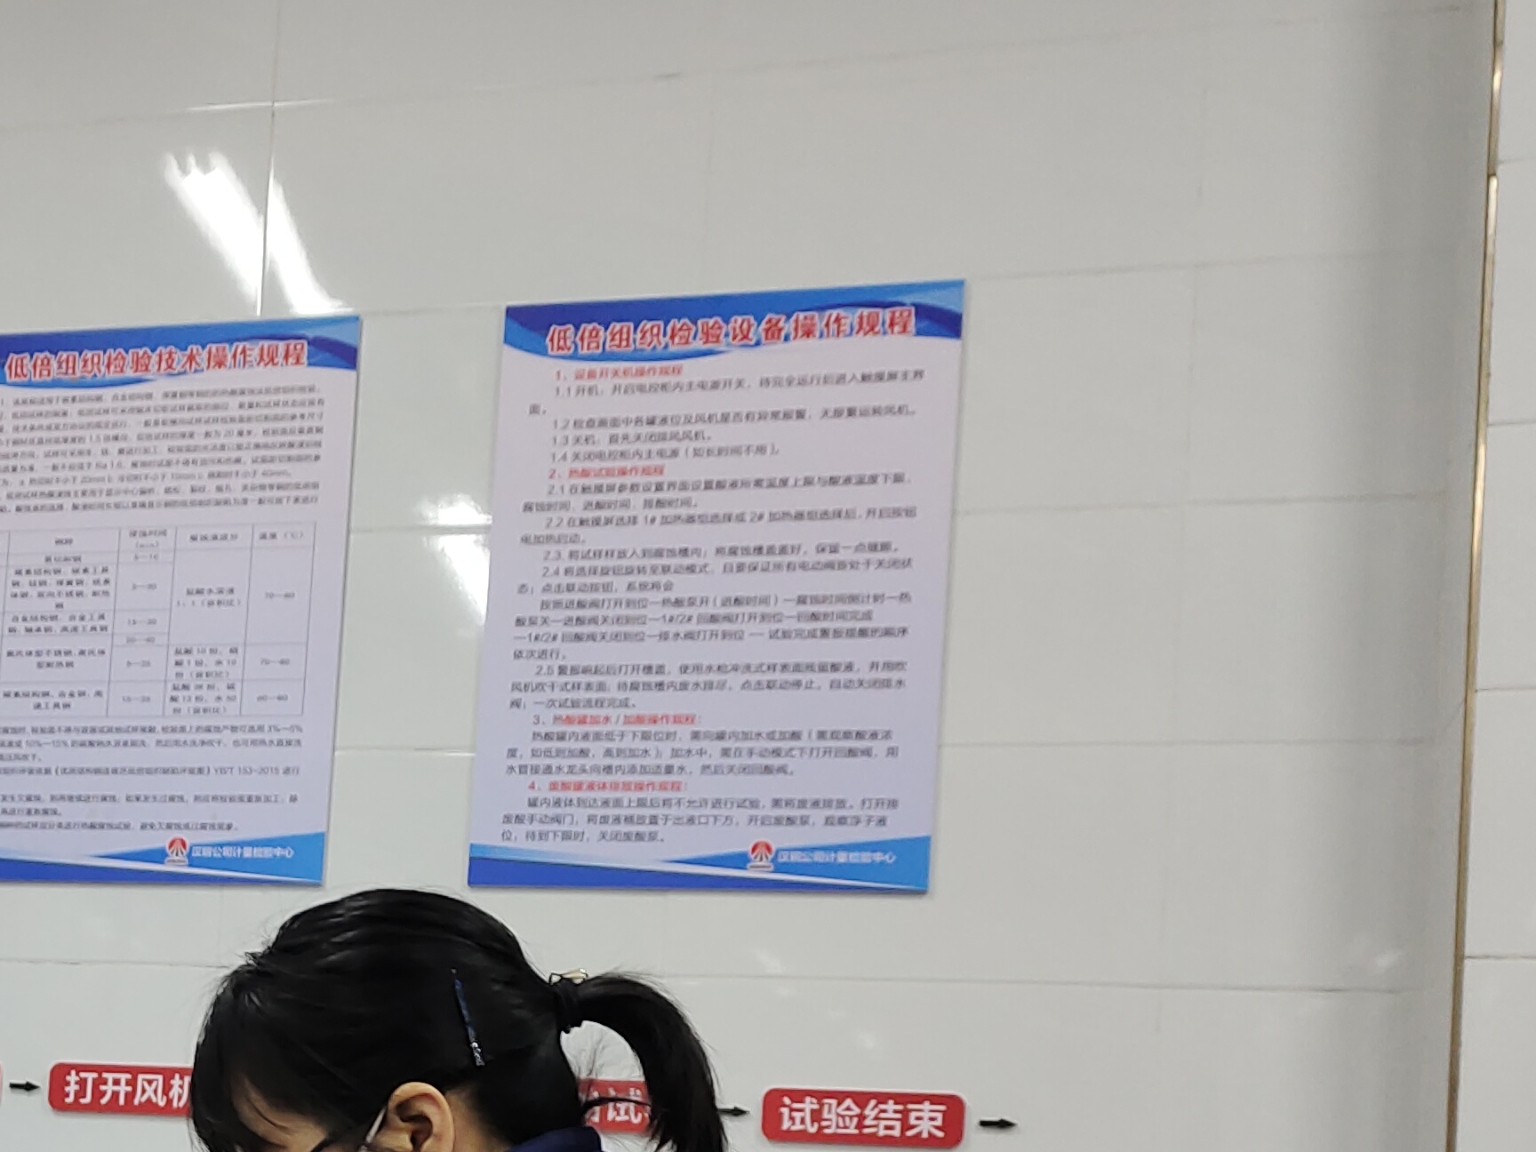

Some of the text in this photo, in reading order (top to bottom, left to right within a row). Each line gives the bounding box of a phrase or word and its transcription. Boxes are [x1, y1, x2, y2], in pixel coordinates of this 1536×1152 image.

[546, 306, 916, 355] 低倍组织检验设备操作规程
[5, 339, 308, 383] 低倍组织检验技术操作规程
[779, 1096, 947, 1140] 试验结束
